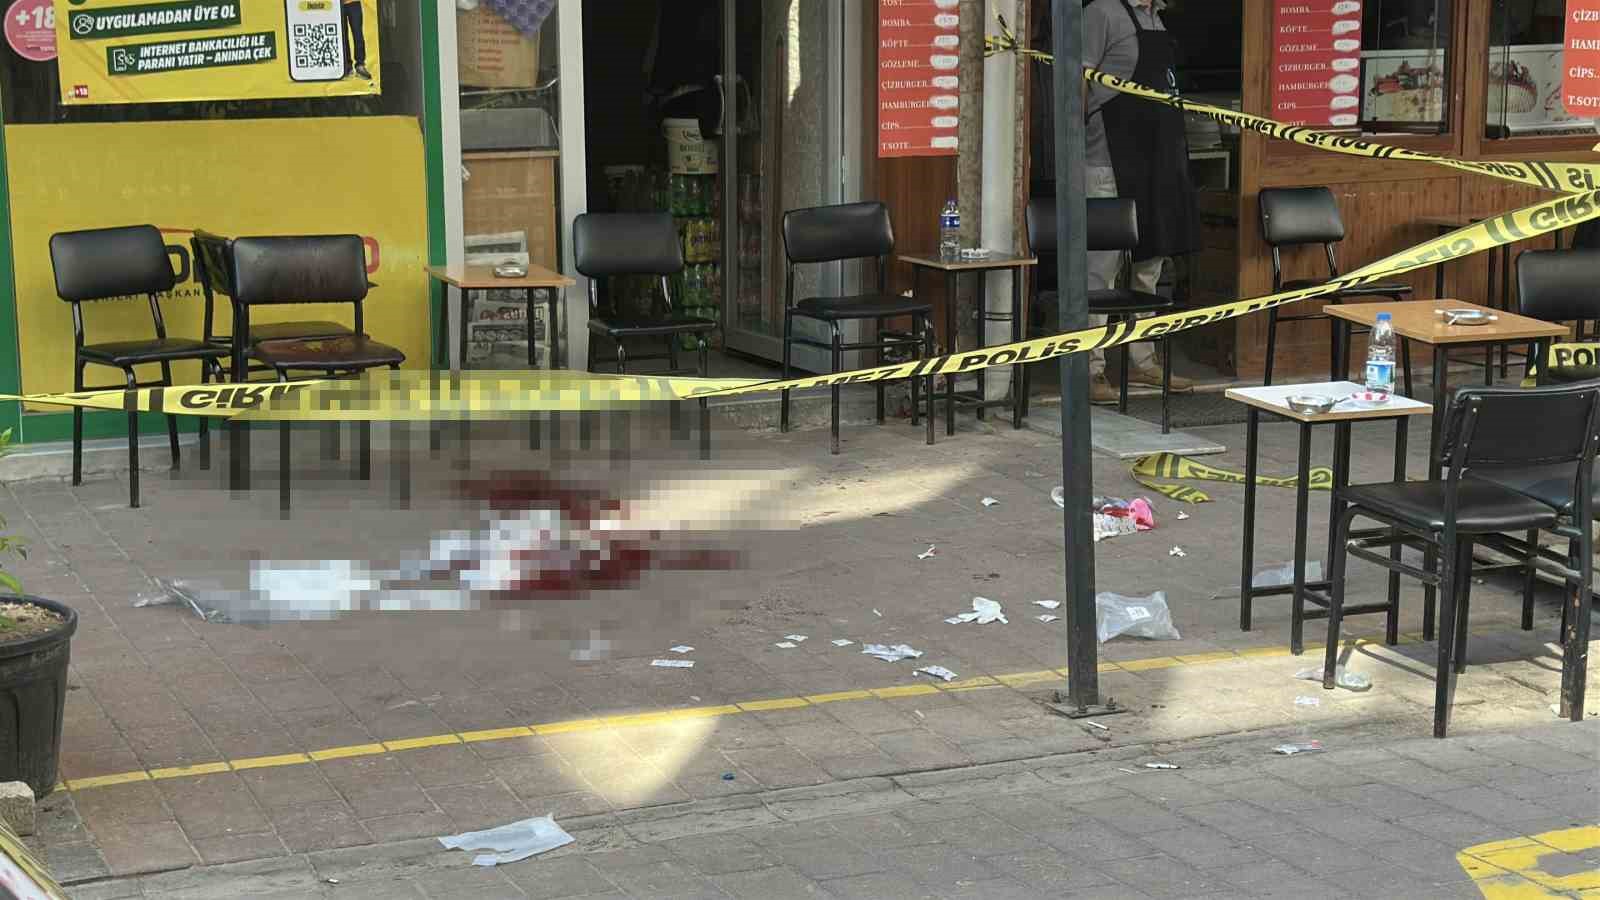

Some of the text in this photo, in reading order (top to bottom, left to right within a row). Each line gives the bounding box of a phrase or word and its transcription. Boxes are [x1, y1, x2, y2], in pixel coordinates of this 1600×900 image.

[96, 5, 236, 31] UYGULAMADAN ÜYE OL
[1572, 9, 1600, 23] ÇİZB
[1571, 39, 1600, 49] HAM
[138, 56, 176, 71] PARANI
[177, 53, 204, 67] YATIR
[214, 49, 252, 64] ANINDA
[253, 47, 272, 62] ÇEK
[1568, 95, 1600, 107] T.SOT
[958, 338, 1081, 371] POLİS
[1554, 347, 1600, 368] PO
